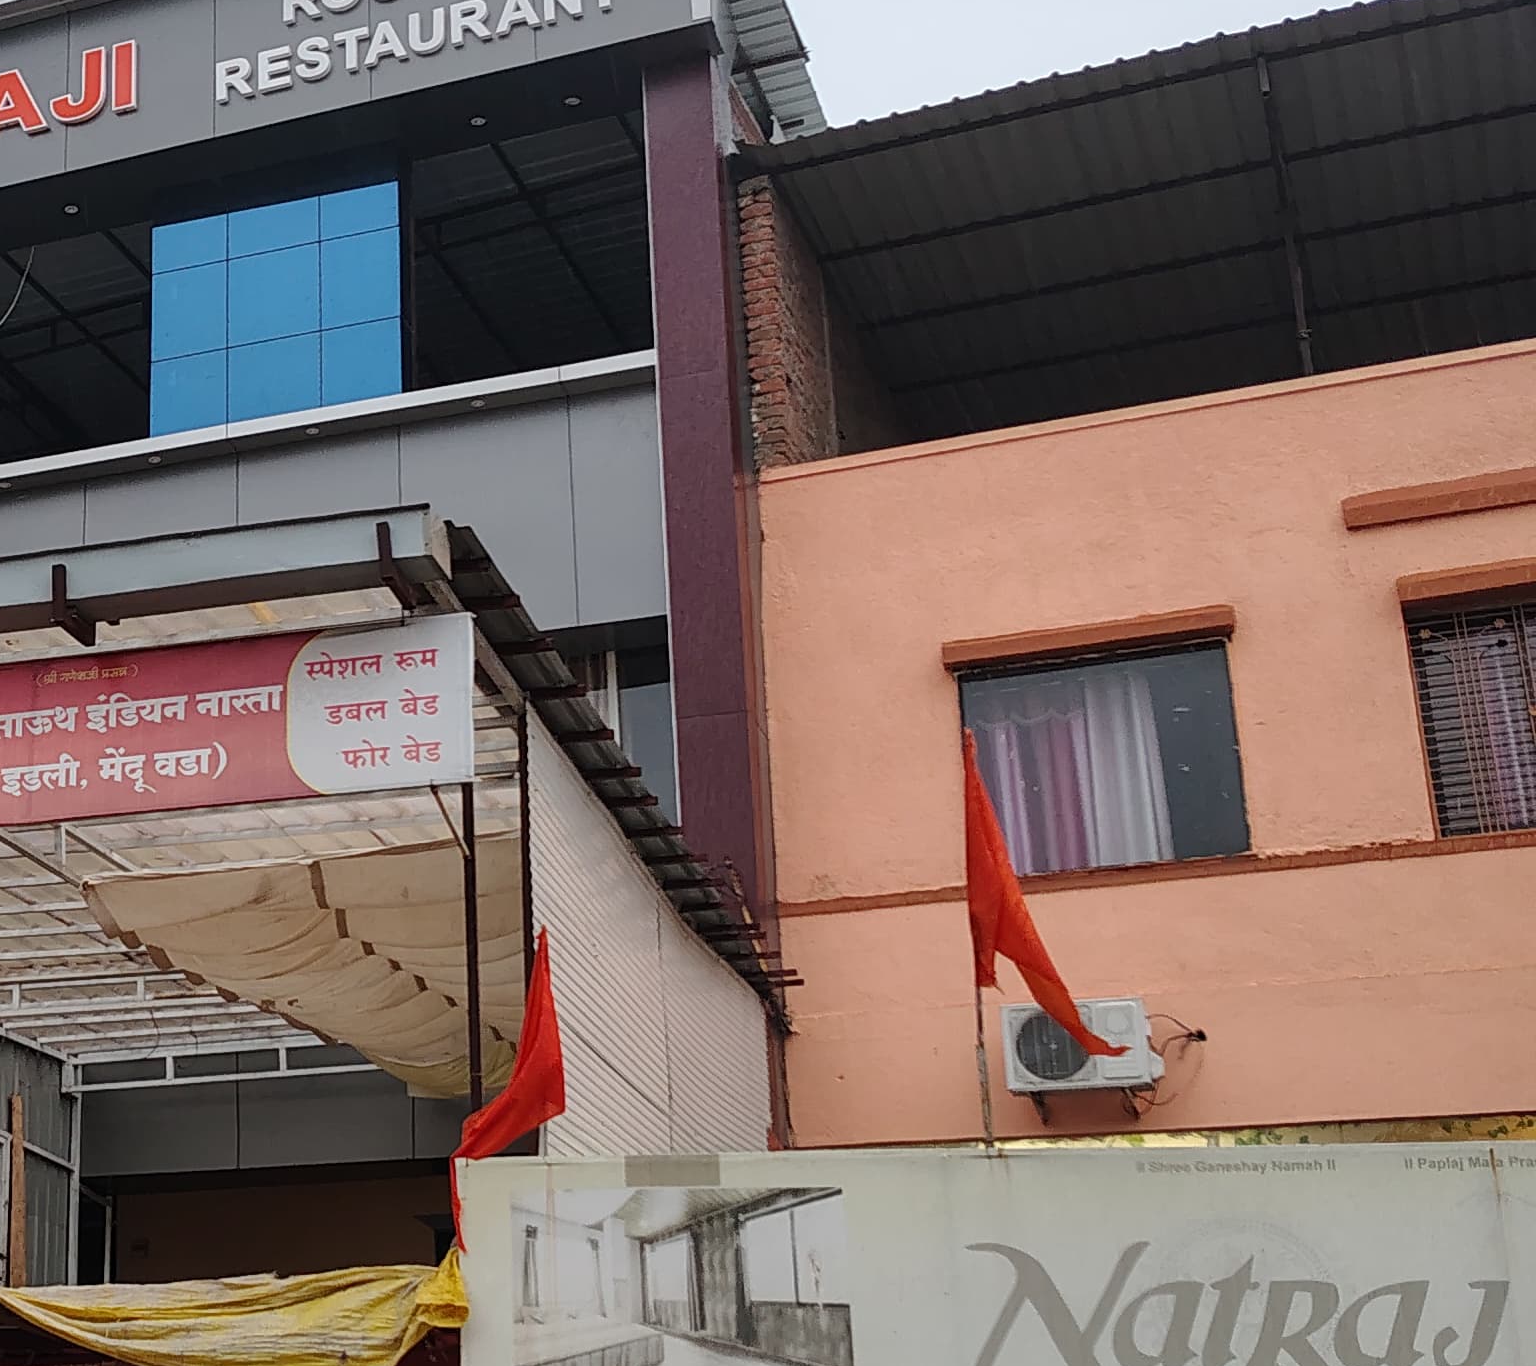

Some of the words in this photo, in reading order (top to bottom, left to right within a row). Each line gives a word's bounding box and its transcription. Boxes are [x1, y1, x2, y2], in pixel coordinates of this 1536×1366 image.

[304, 652, 383, 680] स्पेशल
[85, 693, 188, 733] इंडियन
[195, 684, 284, 718] नास्ता
[324, 700, 388, 725] डबल
[399, 688, 439, 715] बेड
[154, 741, 229, 780] वडा)
[341, 739, 390, 769] फोर
[401, 735, 442, 763] बेड
